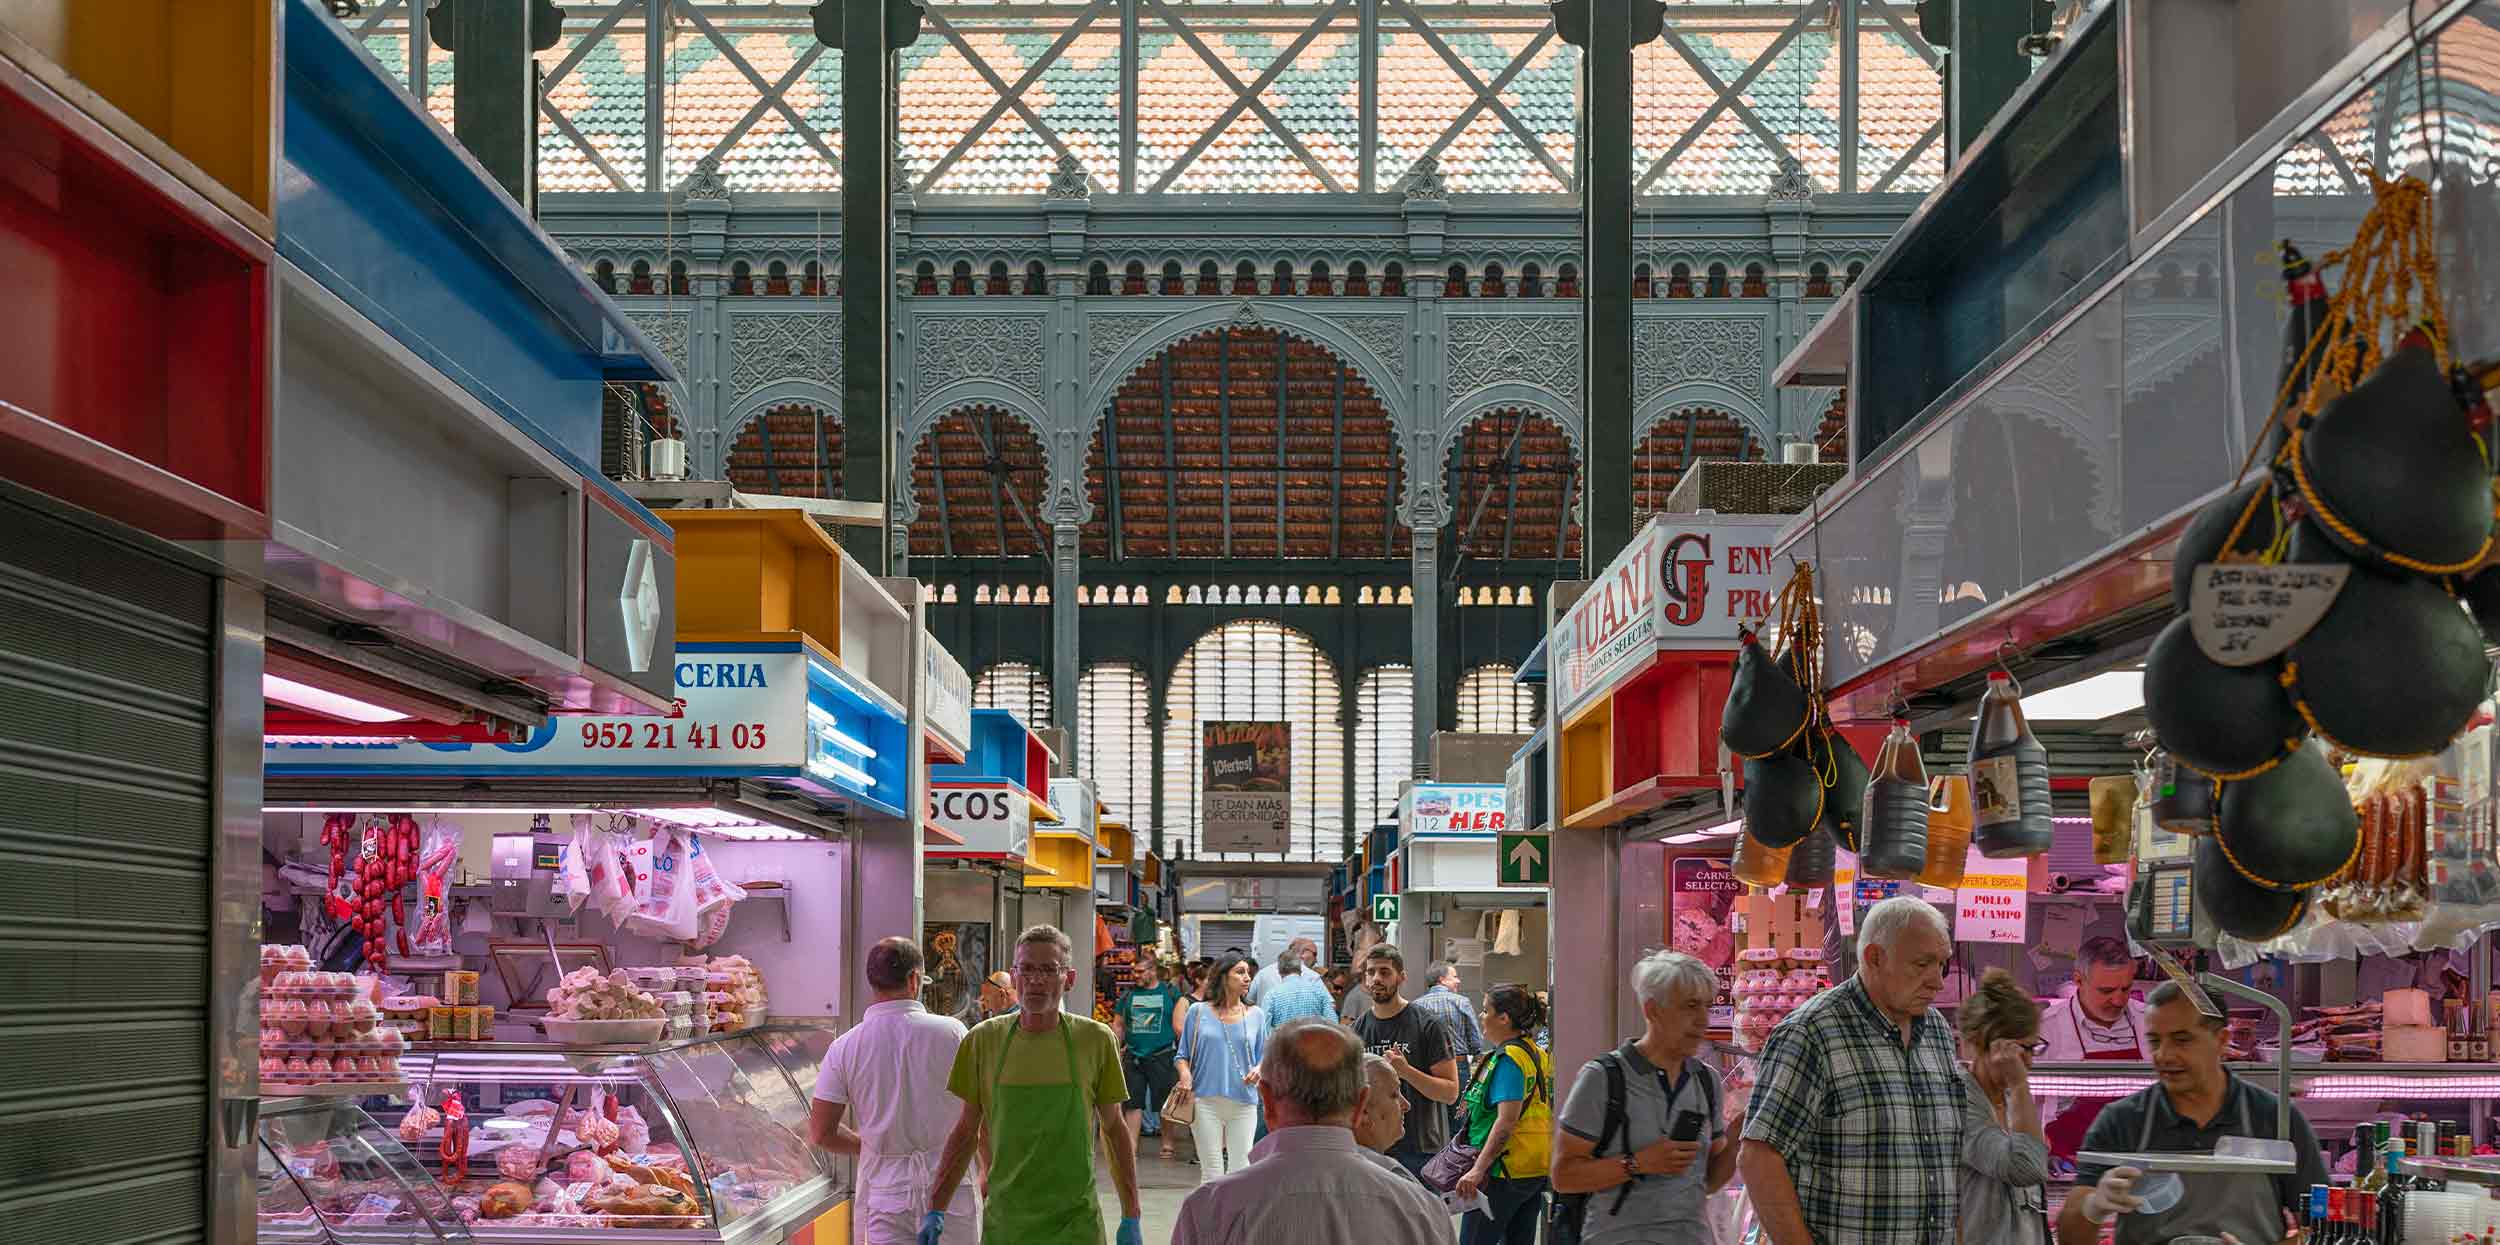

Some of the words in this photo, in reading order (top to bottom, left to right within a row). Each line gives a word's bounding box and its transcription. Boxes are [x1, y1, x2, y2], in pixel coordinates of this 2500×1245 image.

[1572, 539, 1654, 692] JUANI
[1585, 646, 1613, 680] CARNES
[1613, 616, 1654, 657] SELECTAS
[674, 663, 769, 689] CERIA
[581, 722, 634, 750] 952
[643, 722, 678, 750] 21
[687, 720, 722, 750] 41
[731, 723, 767, 750] 03
[1211, 799, 1224, 810] TE
[1227, 799, 1254, 810] DAN
[1457, 791, 1505, 809] PES
[1415, 816, 1441, 831] 112
[1448, 810, 1505, 832] HER
[1685, 881, 1739, 891] SELECTAS
[1974, 895, 2012, 905] POLLO
[1962, 908, 1978, 919] DE
[1981, 908, 2022, 920] CAMPO
